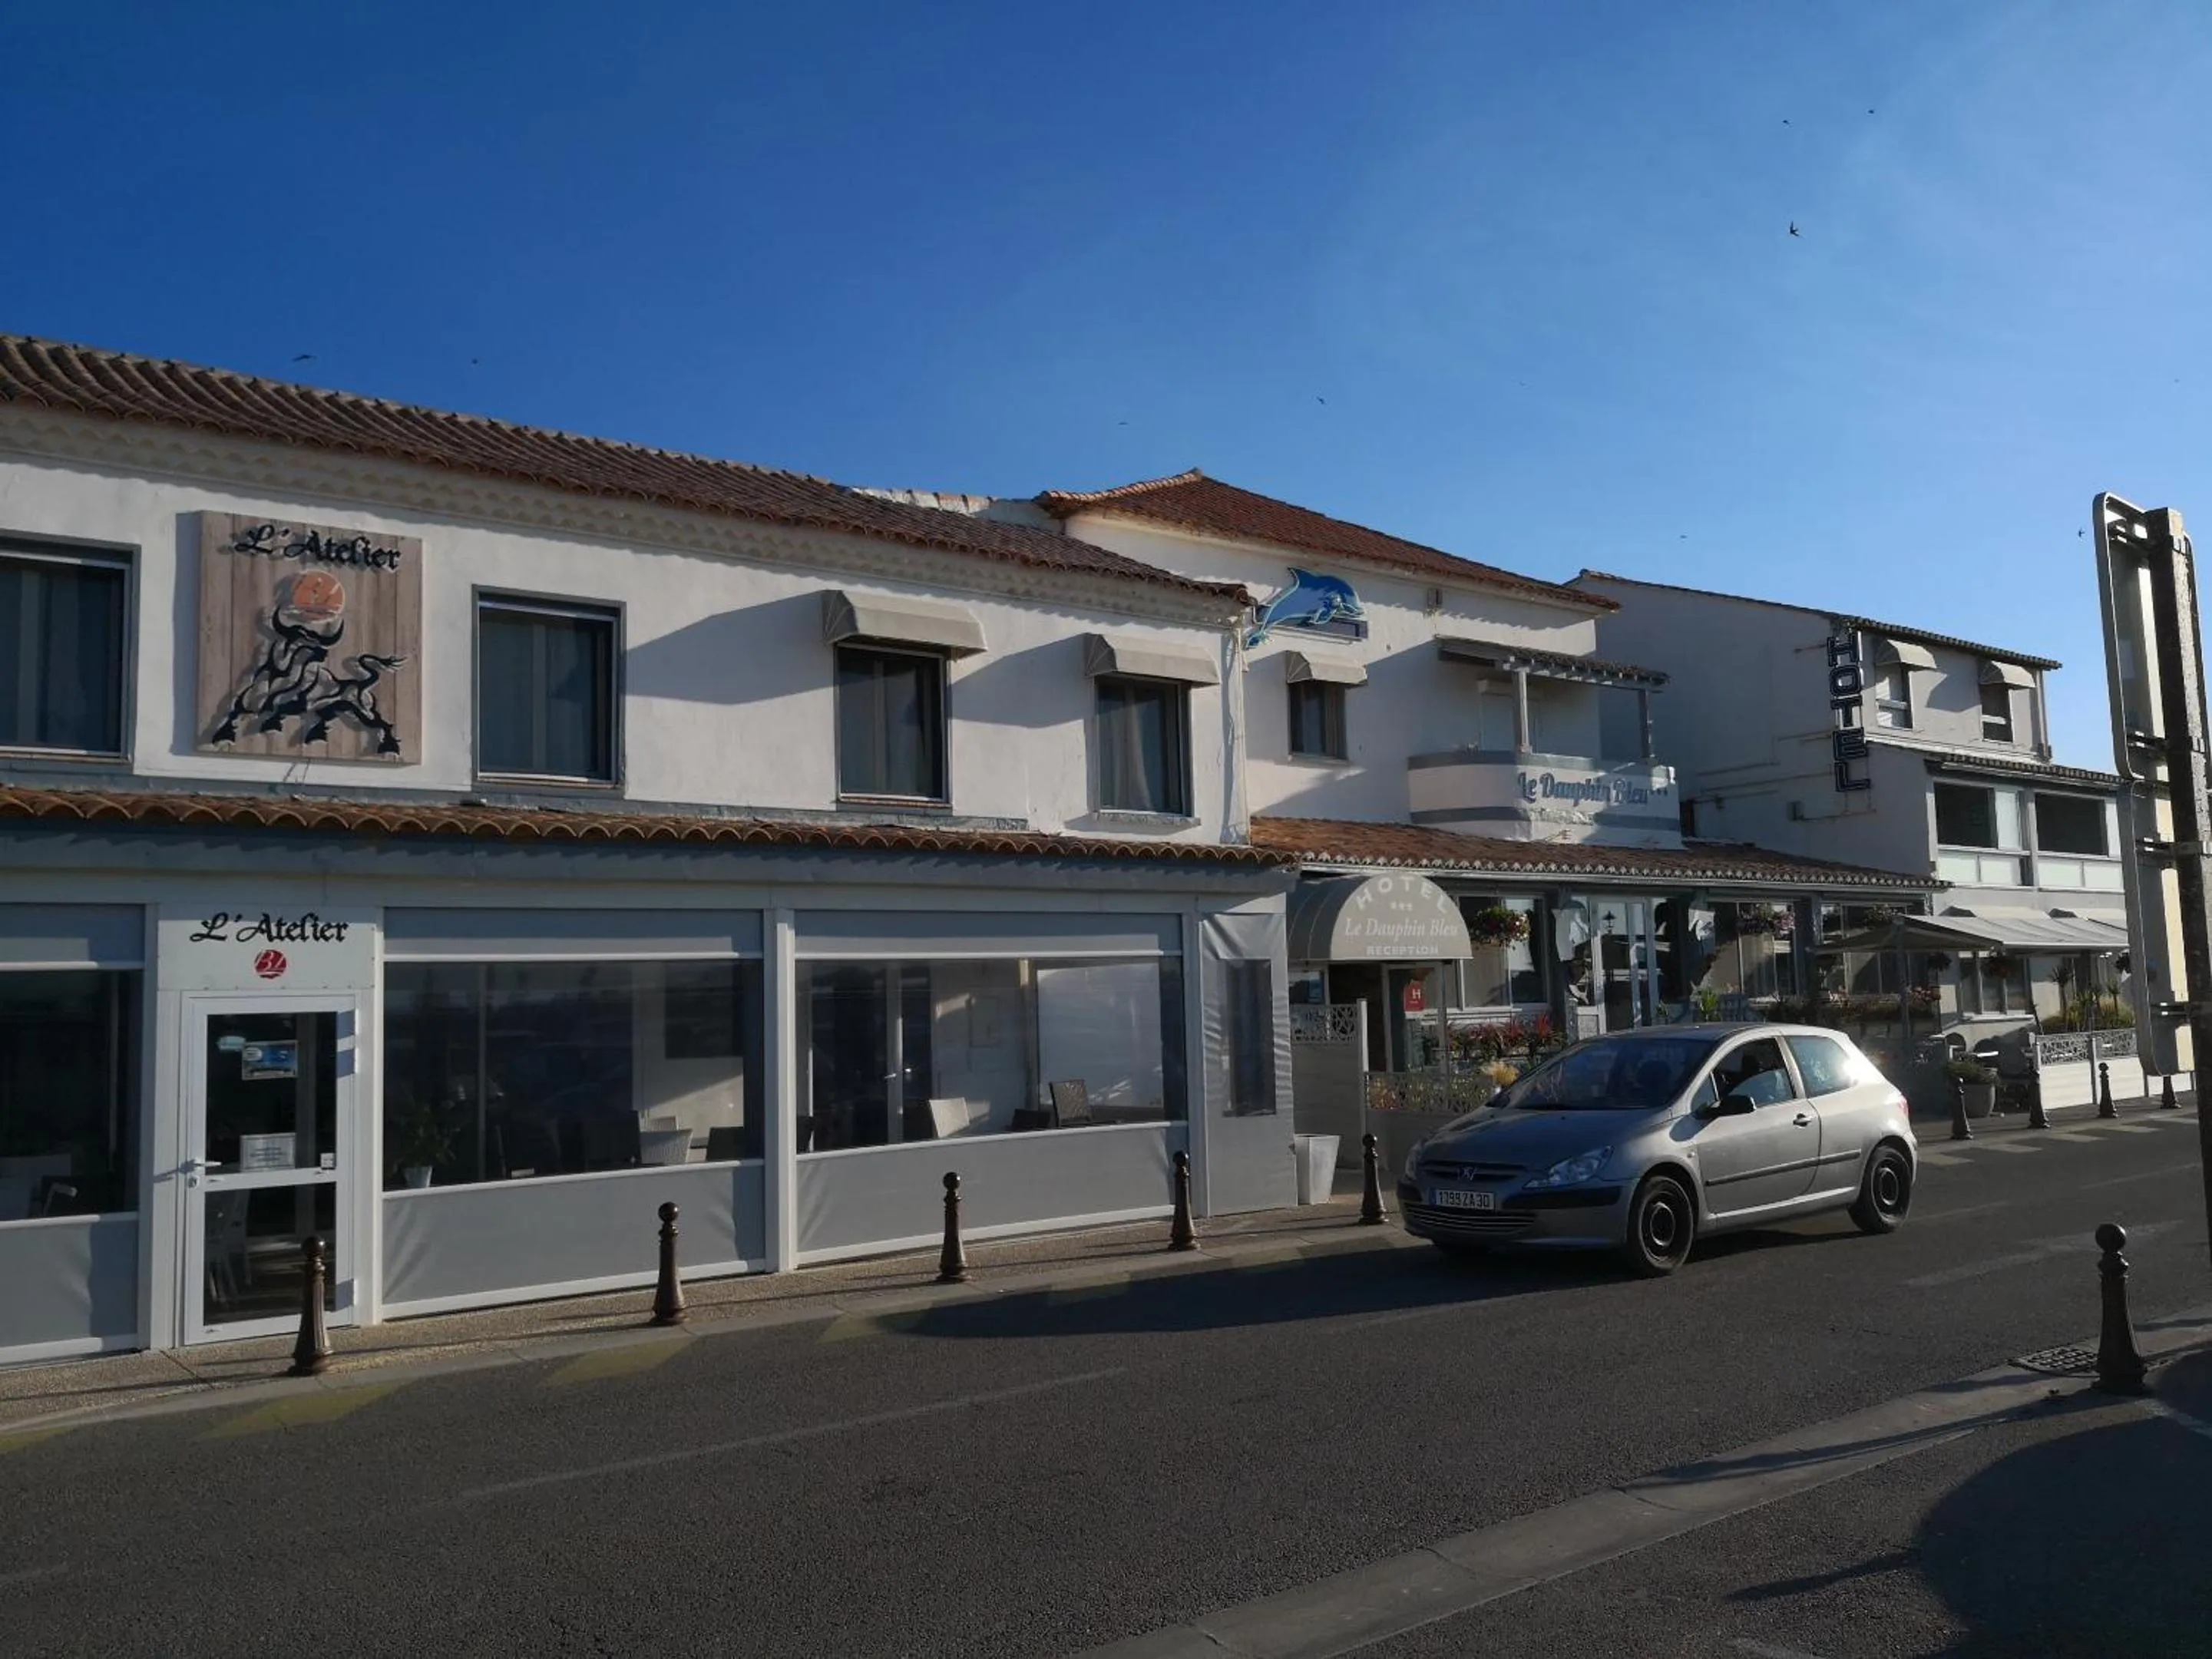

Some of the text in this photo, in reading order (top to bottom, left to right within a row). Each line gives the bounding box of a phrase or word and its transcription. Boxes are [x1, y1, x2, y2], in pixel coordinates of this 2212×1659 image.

[1827, 633, 1871, 792] HOTEL
[1518, 772, 1537, 803] Le
[1540, 772, 1611, 807] Dauphin
[1356, 877, 1447, 914] HOTEL
[1344, 917, 1459, 943] Le Dauphin Bleu
[1366, 945, 1439, 956] RECEPTION
